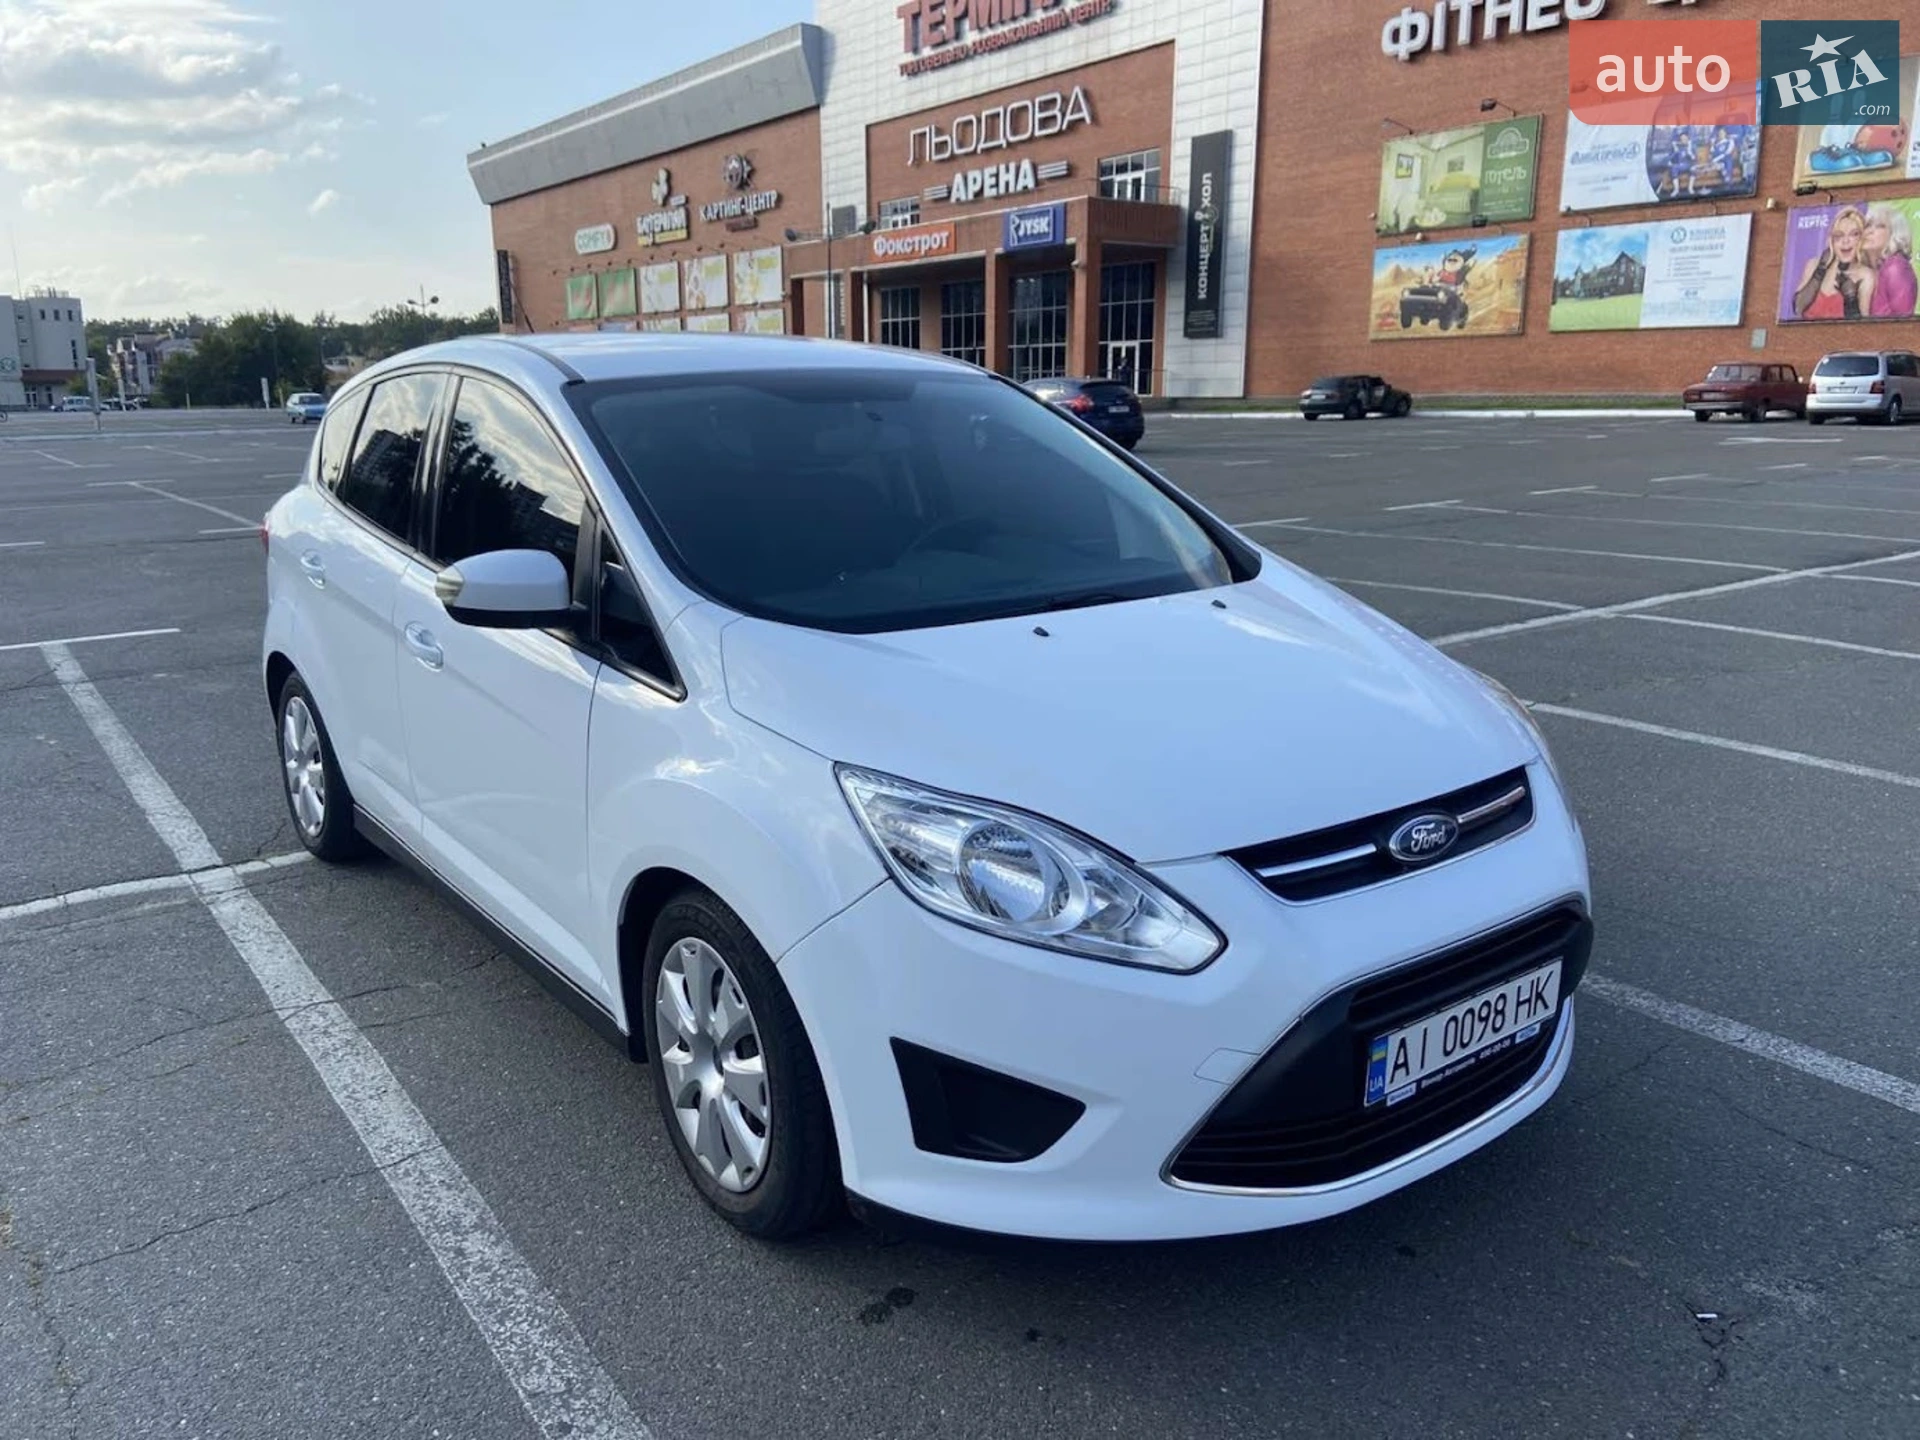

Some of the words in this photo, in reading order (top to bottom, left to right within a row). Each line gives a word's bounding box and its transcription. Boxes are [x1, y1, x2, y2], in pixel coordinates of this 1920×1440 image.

[907, 85, 1092, 167] ЛЬОДОВА
[951, 158, 1037, 203] АРЕНА
[1201, 172, 1212, 208] ХОЛ
[699, 190, 778, 221] КАРТИНГ-ЦЕНТР
[1018, 214, 1050, 237] JYSK
[873, 231, 950, 257] Фокстрот
[1197, 224, 1210, 299] КОНЦЕРТ
[1410, 822, 1447, 852] Ford
[1443, 992, 1507, 1057] 0098
[1513, 969, 1554, 1026] HK
[1369, 1075, 1384, 1092] UA
